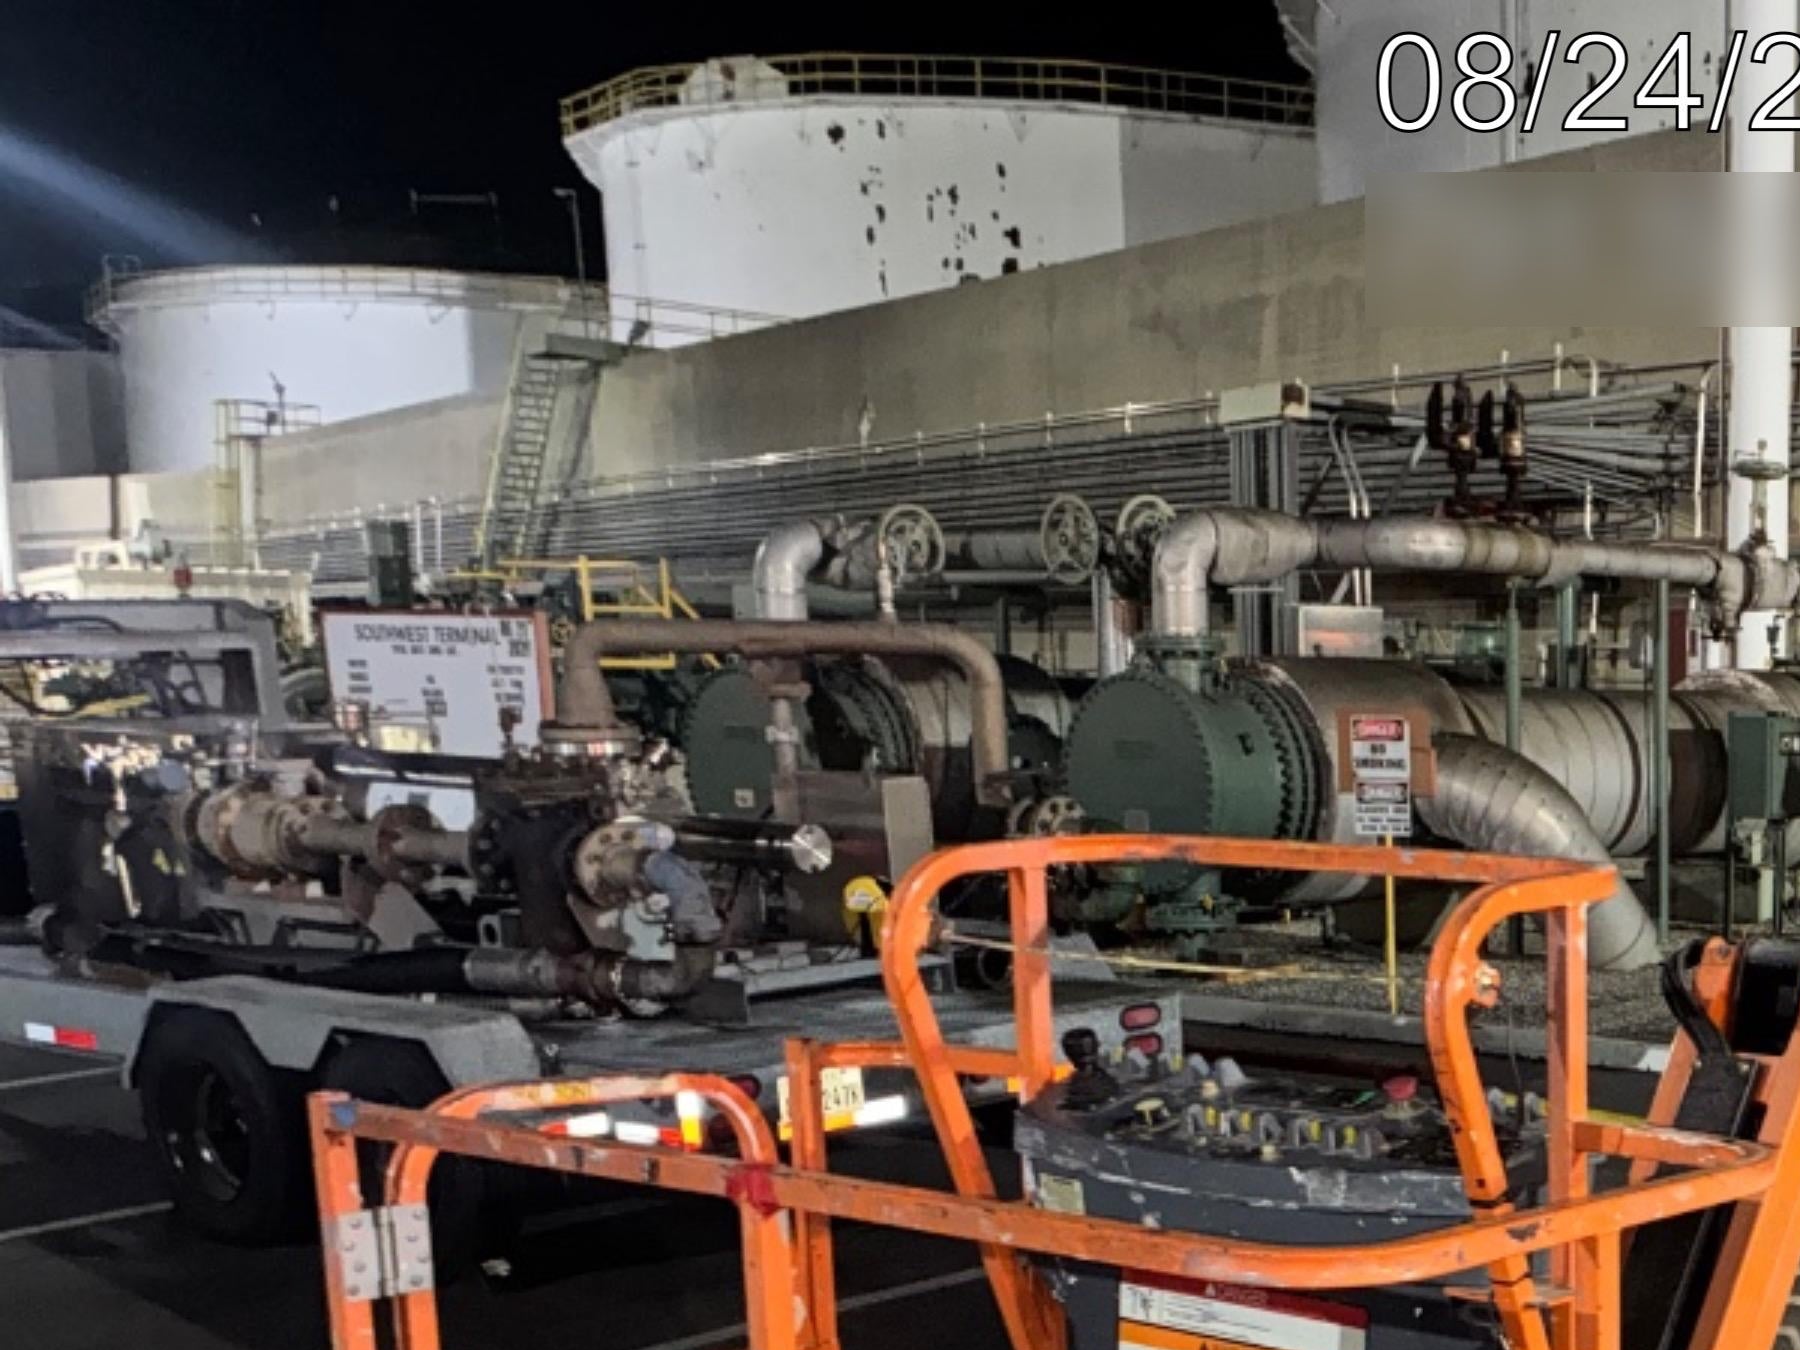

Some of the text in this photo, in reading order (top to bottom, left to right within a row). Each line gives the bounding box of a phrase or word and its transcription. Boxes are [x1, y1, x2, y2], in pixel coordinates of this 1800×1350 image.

[353, 624, 429, 643] SOUTHWEST
[433, 626, 500, 645] TERMINAL
[1370, 744, 1386, 754] NO
[1355, 758, 1405, 769] SMOKING
